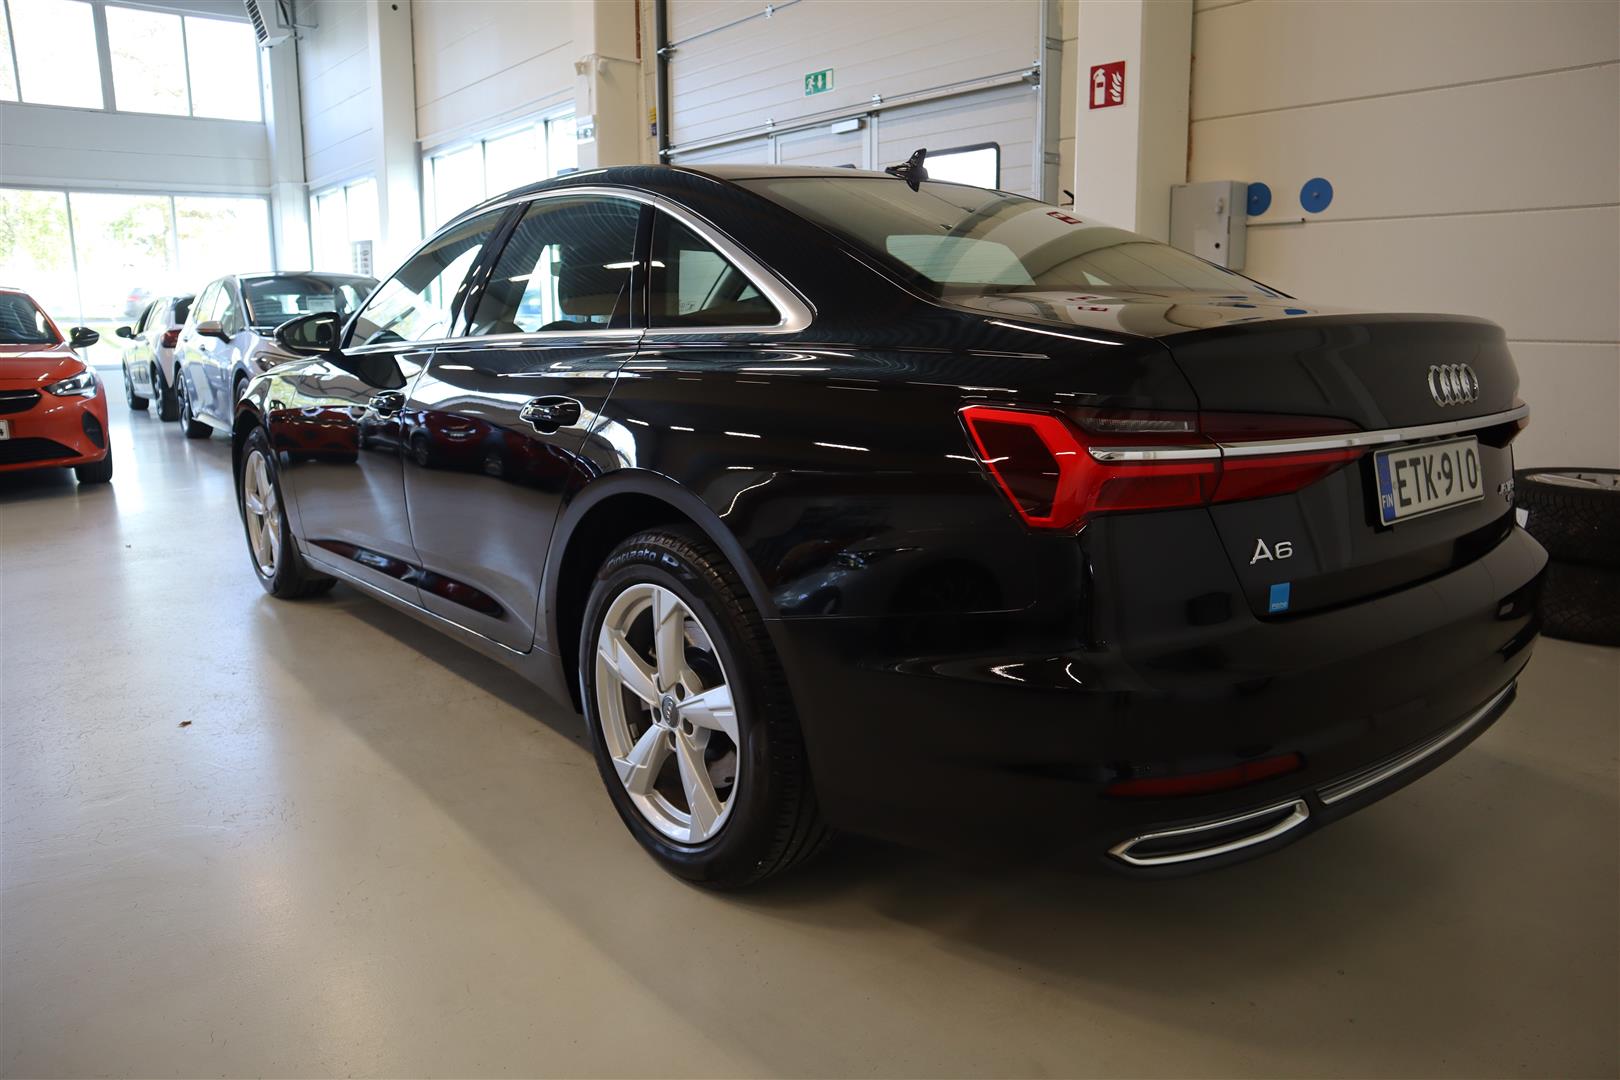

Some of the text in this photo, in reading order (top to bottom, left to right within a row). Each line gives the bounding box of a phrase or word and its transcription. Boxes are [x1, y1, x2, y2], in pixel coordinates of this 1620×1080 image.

[1395, 448, 1478, 507] ETK-910
[1382, 494, 1394, 508] FIN
[1250, 538, 1293, 565] A6
